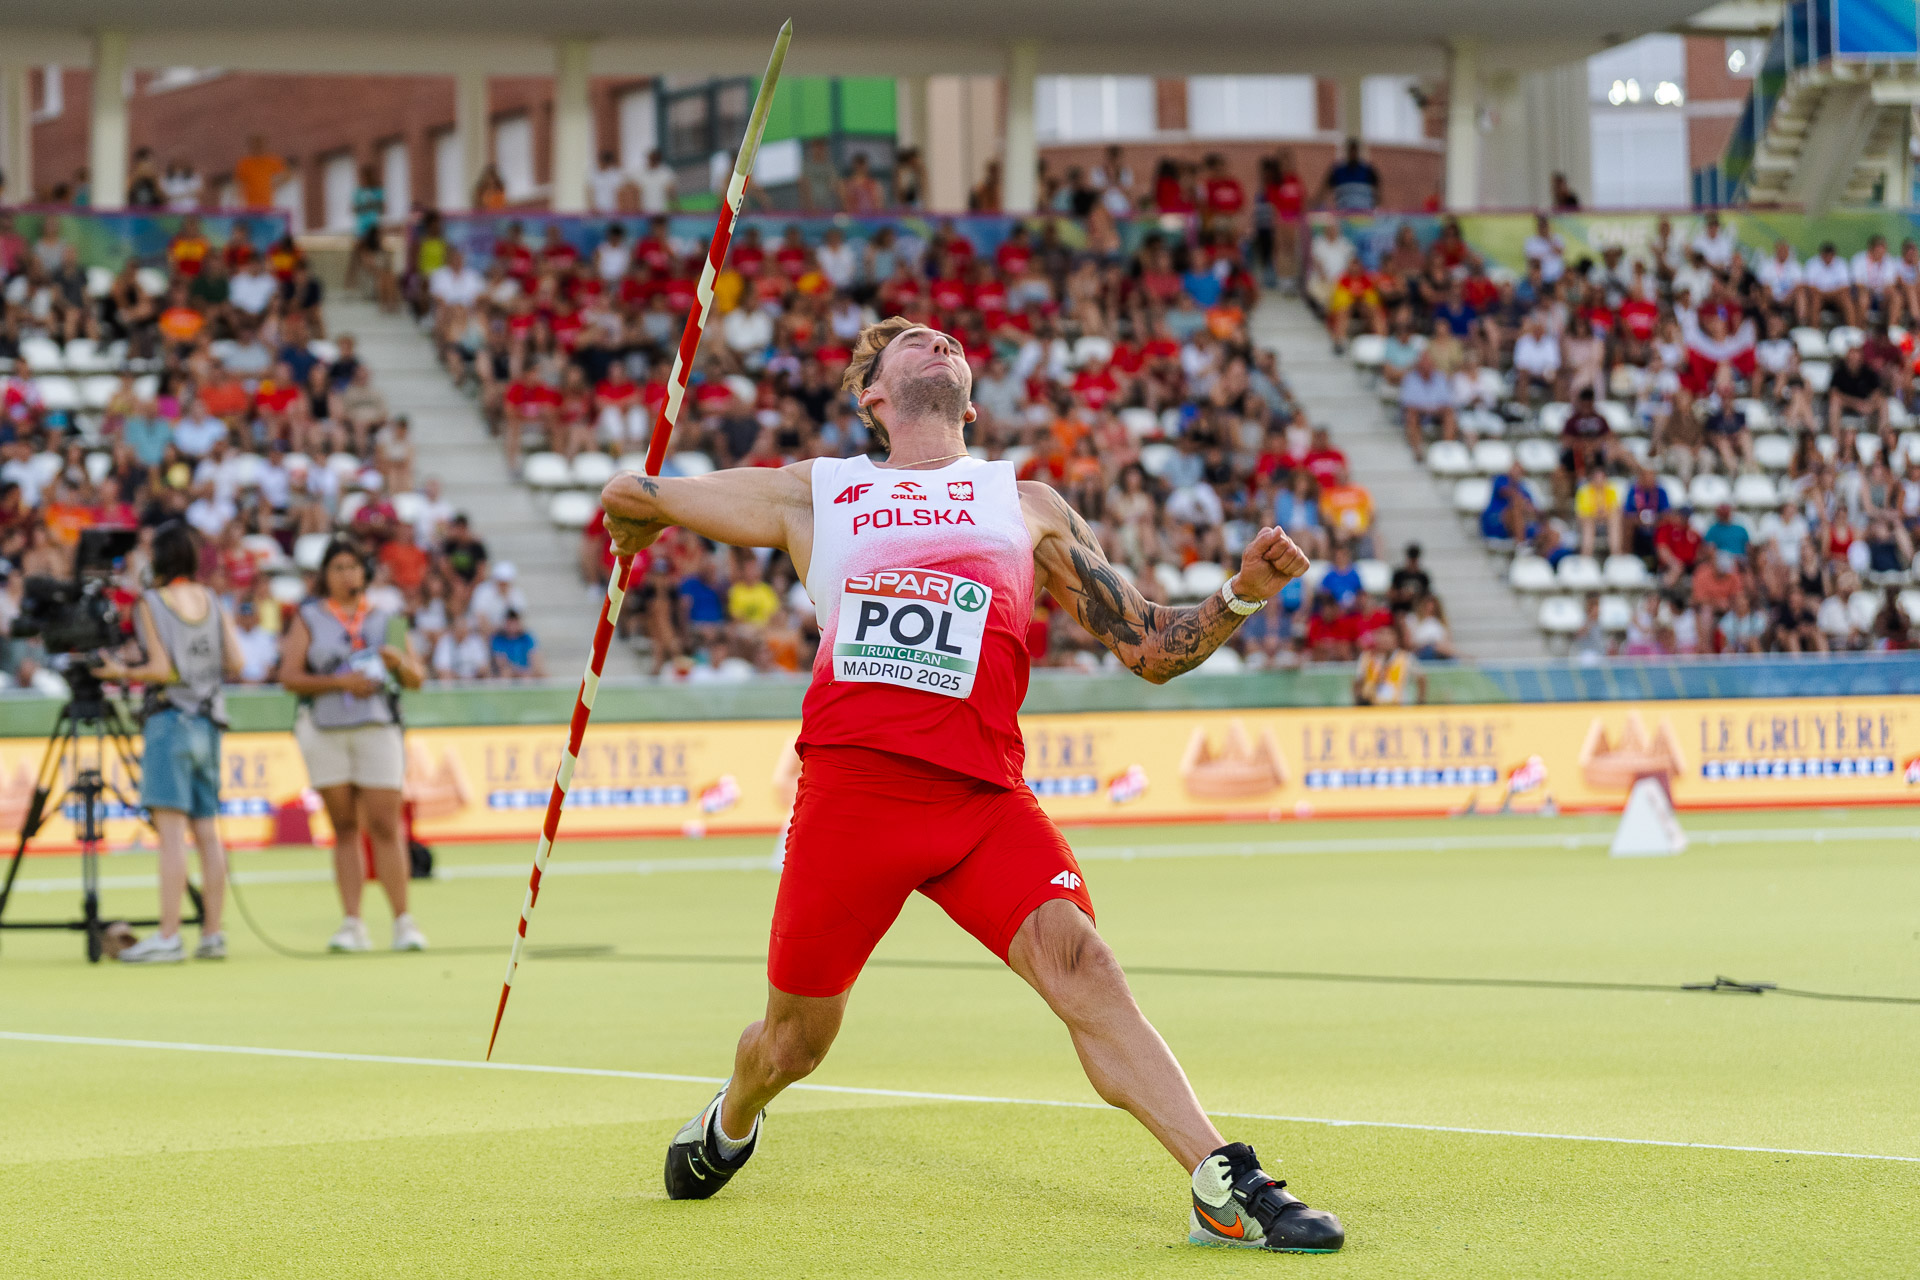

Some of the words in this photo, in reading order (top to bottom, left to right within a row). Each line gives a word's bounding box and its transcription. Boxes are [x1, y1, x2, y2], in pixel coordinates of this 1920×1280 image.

[834, 483, 874, 504] 4F
[853, 508, 976, 535] POLSKA
[848, 573, 949, 600] SPAR
[855, 600, 962, 655] POL
[861, 645, 867, 656] I
[867, 646, 895, 657] RUN
[843, 661, 913, 681] MADRID
[917, 669, 961, 691] 2025
[1303, 724, 1335, 762] LE
[1701, 715, 1735, 752] LE
[1746, 708, 1895, 751] GRUYÈRE
[486, 743, 521, 781] LE
[1704, 756, 1890, 783] SWITZERLAND
[1050, 870, 1082, 890] 4F
